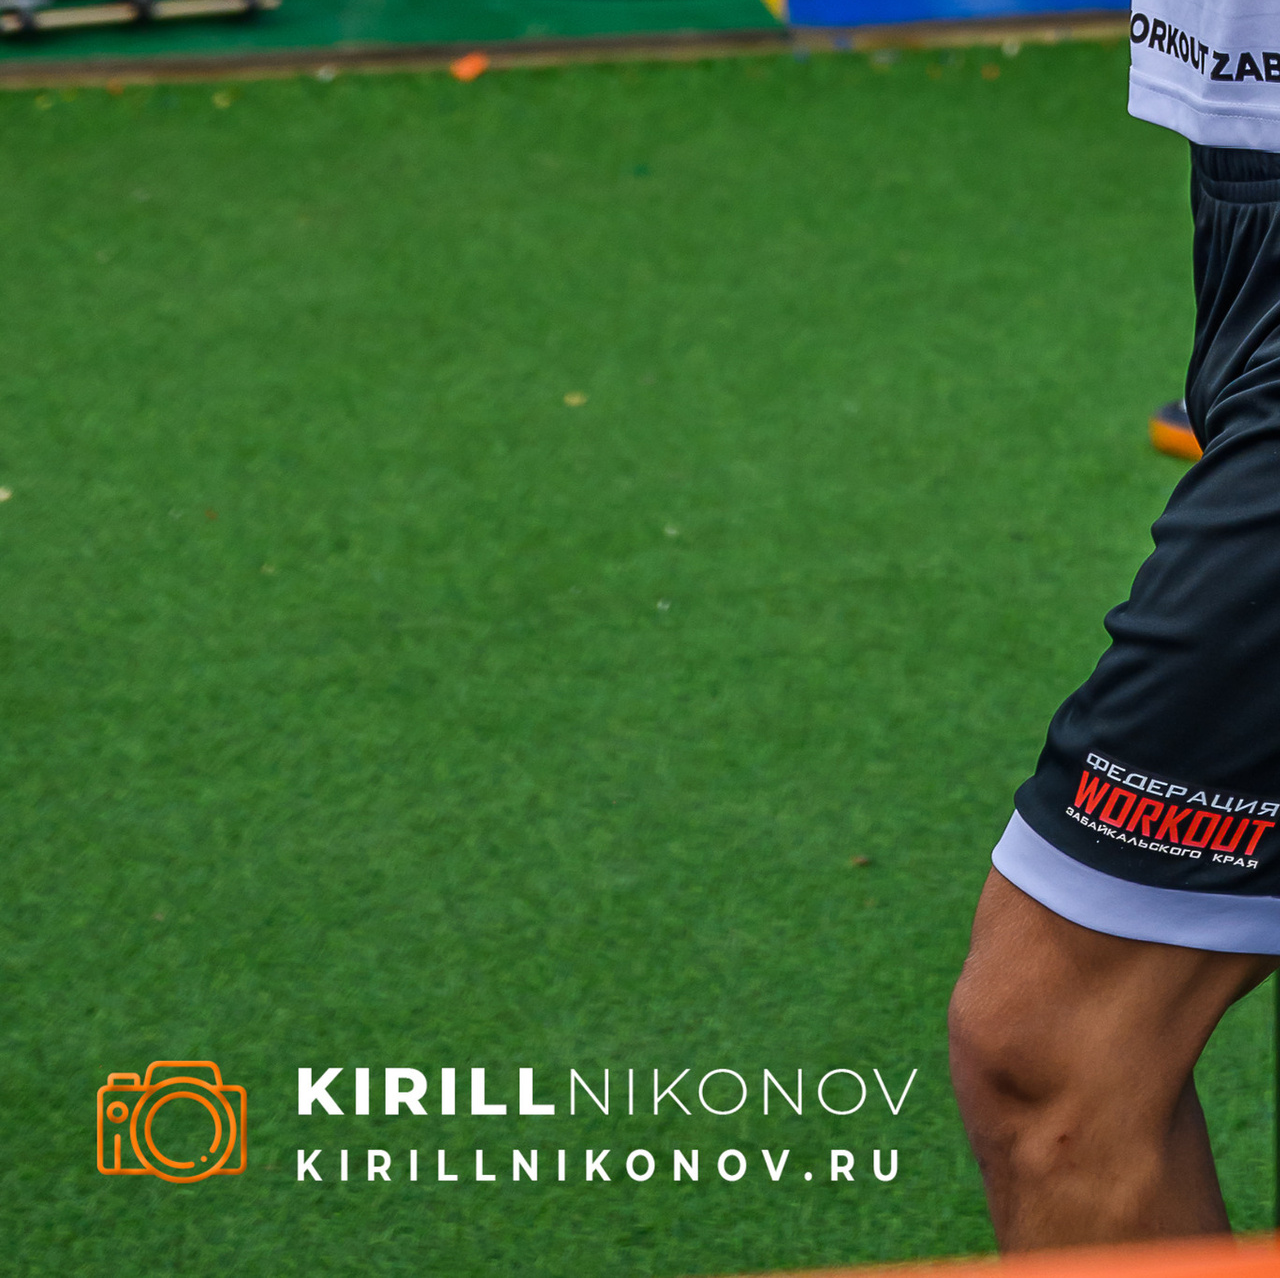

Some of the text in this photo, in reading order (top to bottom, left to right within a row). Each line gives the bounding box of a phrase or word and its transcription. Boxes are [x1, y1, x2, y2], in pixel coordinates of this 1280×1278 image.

[1129, 11, 1210, 76] ORKOUT
[1073, 769, 1276, 857] WORKOUT
[1085, 752, 1280, 818] ФЕДЕРАЦИЯ
[1065, 806, 1259, 870] ЗАБАЙКАЛЬСКОГО КРАЯ
